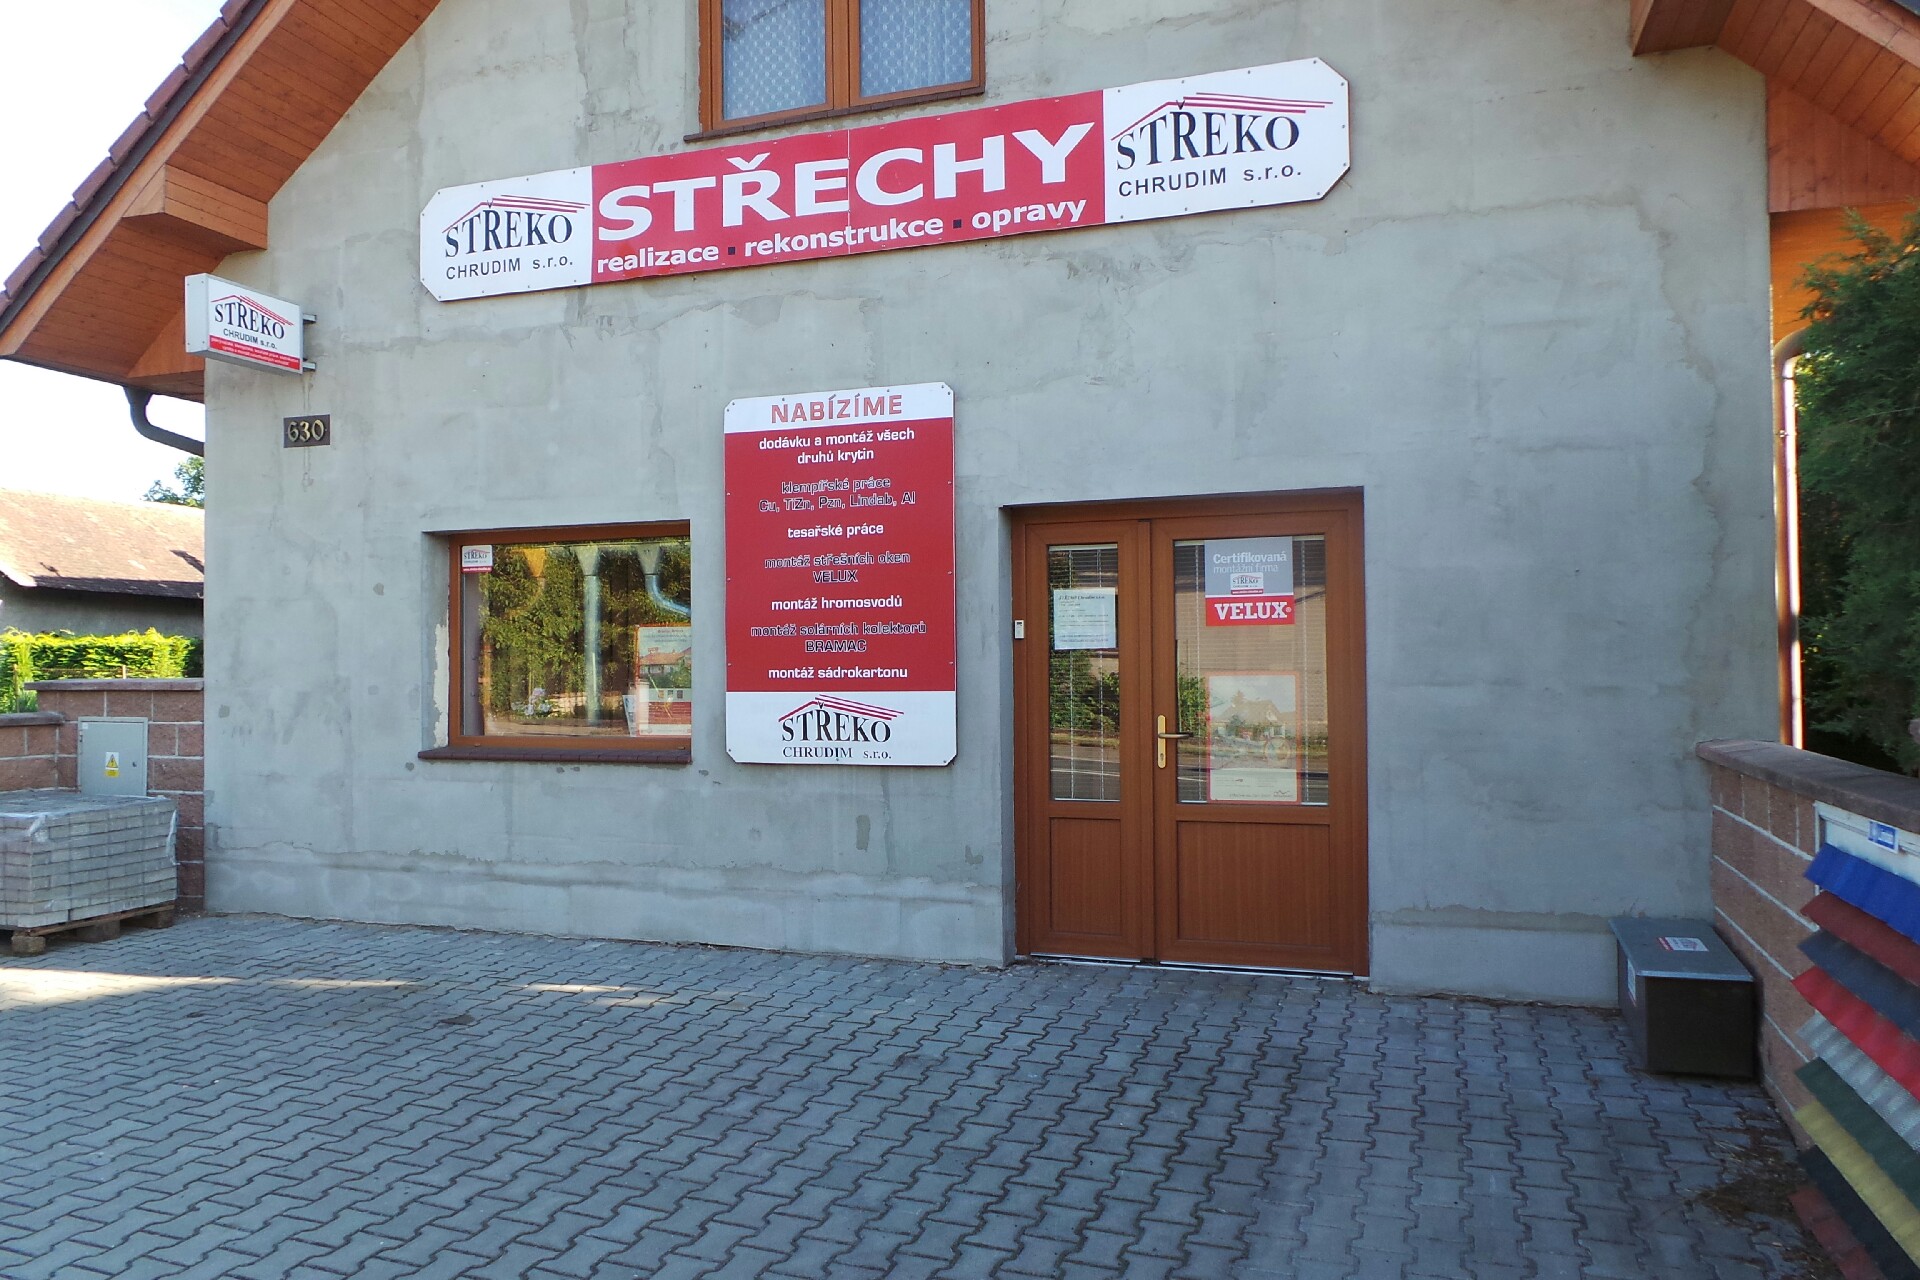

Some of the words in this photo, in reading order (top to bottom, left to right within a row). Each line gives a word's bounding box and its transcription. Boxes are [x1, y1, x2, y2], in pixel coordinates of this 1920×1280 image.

[1117, 100, 1300, 171] STŘEKO
[598, 122, 1095, 241] STŘECHY
[1118, 167, 1227, 197] CHRUDIM
[1243, 164, 1302, 182] s.r.o.
[444, 200, 572, 258] STŘEKO
[597, 243, 719, 274] realizace
[744, 216, 943, 257] rekonstrukce
[971, 199, 1086, 230] opravy
[446, 258, 521, 280] CHRUDIM
[532, 256, 573, 271] s.r.o.
[214, 299, 285, 340] STŘEKO
[223, 328, 259, 345] CHRUDIM
[260, 339, 278, 350] s.r.o.
[771, 393, 902, 424] NABÍZÍME
[287, 419, 325, 442] 630
[759, 435, 811, 450] dodávku
[814, 437, 822, 446] a
[826, 430, 874, 446] montáž
[877, 428, 915, 442] všech
[797, 450, 834, 464] druhů
[837, 448, 874, 464] krytin
[782, 478, 849, 495] klempířské
[853, 476, 891, 492] práce
[759, 500, 780, 513] Cu,
[819, 496, 845, 510] Pzn,
[850, 493, 897, 507] Lindab,
[901, 491, 916, 505] Al
[788, 524, 842, 538] tesařské
[847, 522, 884, 538] práce
[764, 555, 811, 568] montáž
[814, 552, 874, 567] střešních
[878, 551, 911, 564] oken
[1213, 551, 1287, 564] Certifikovaná
[1256, 562, 1279, 573] firma
[813, 570, 858, 583] VELUX
[771, 597, 817, 610] montáž
[821, 594, 903, 608] hromosvodů
[1214, 602, 1287, 620] VELUX
[751, 623, 796, 637] montáž
[800, 622, 858, 636] solárních
[863, 621, 926, 634] kolektorů
[805, 640, 866, 652] BRAMAC
[768, 666, 814, 679] montáž
[818, 665, 908, 678] sádrokartonu
[781, 701, 891, 743] STŘEKO
[782, 746, 852, 758] CHRUDIM
[863, 750, 892, 759] s.r.o.
